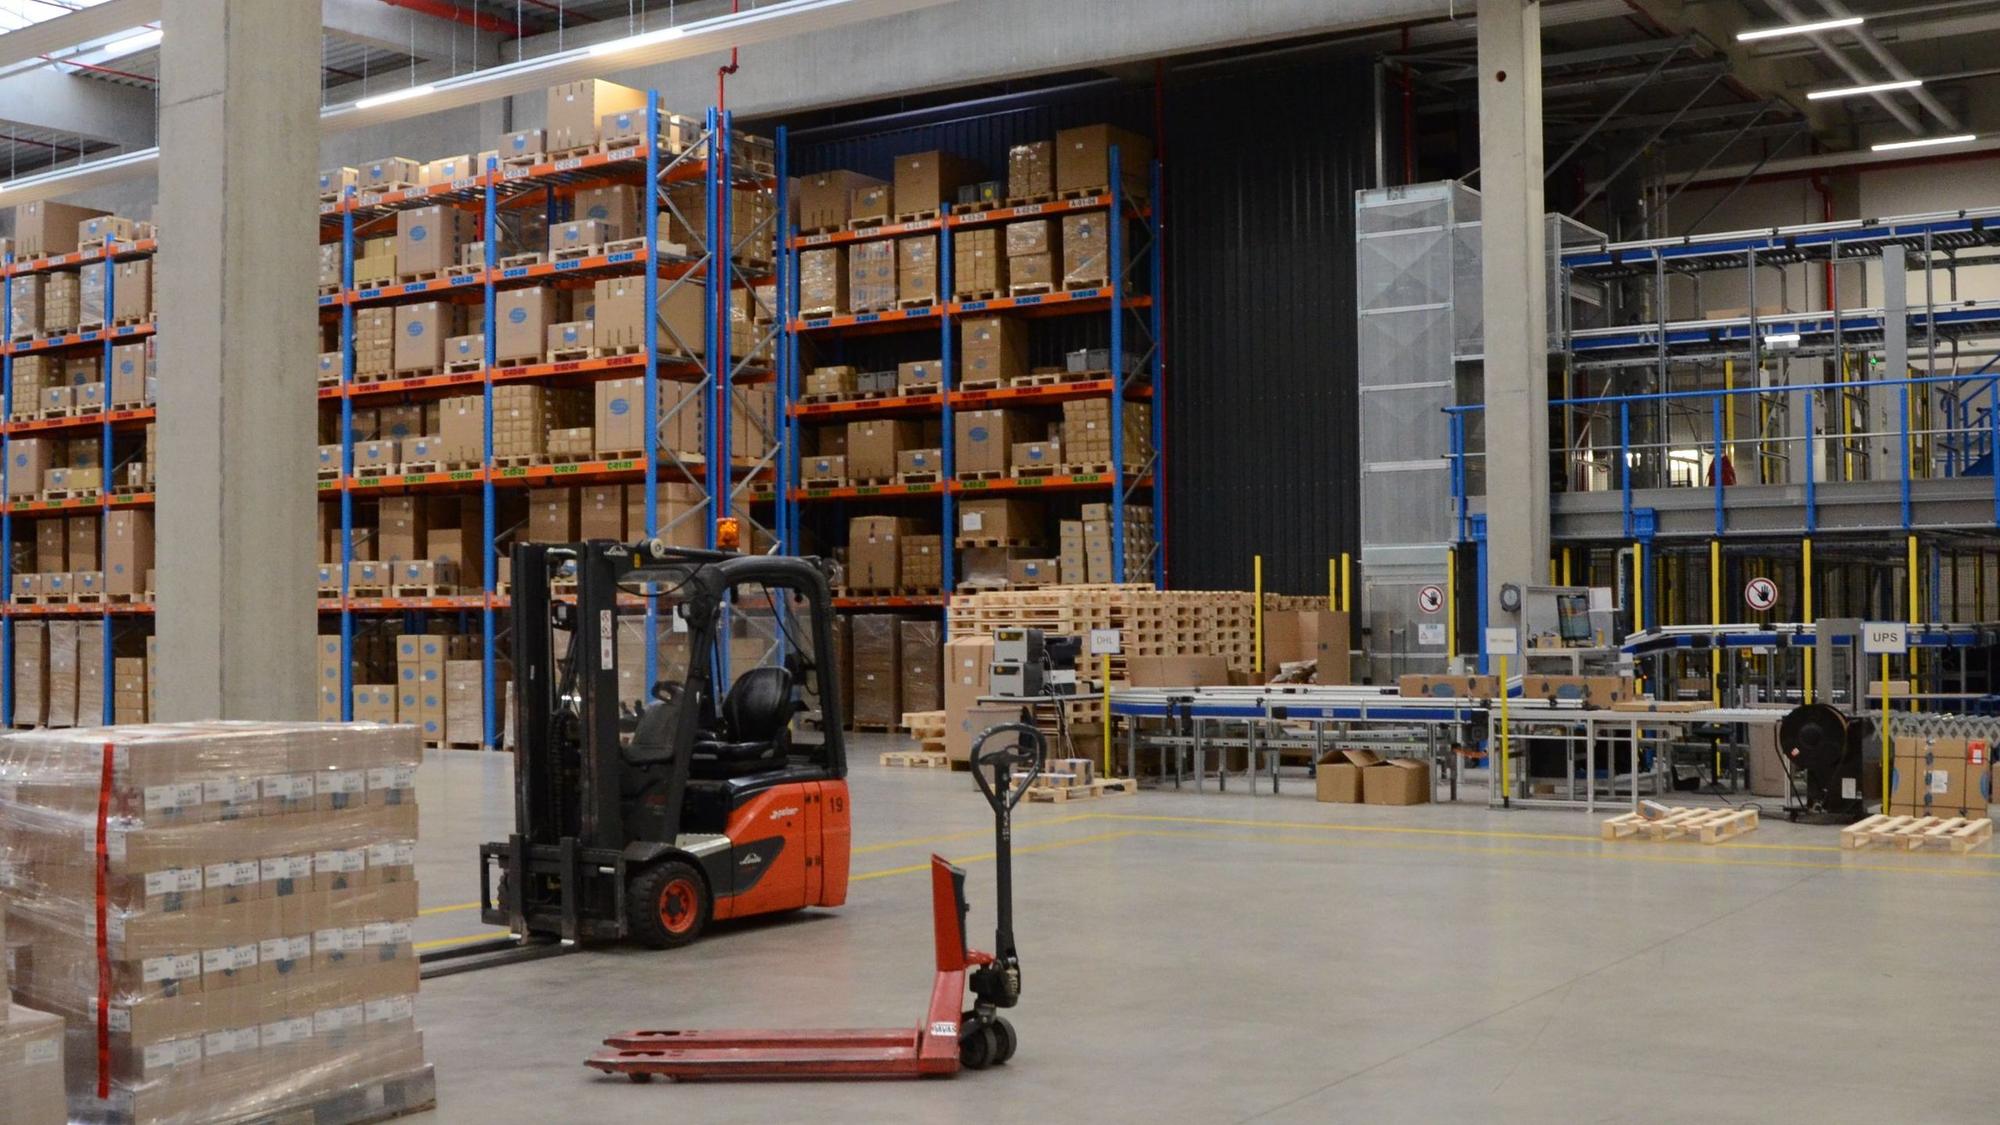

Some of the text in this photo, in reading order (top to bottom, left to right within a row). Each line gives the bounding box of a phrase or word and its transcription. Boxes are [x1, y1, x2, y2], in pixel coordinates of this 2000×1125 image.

[1096, 636, 1113, 644] DHL
[1873, 632, 1898, 642] UPS
[830, 797, 844, 813] 19
